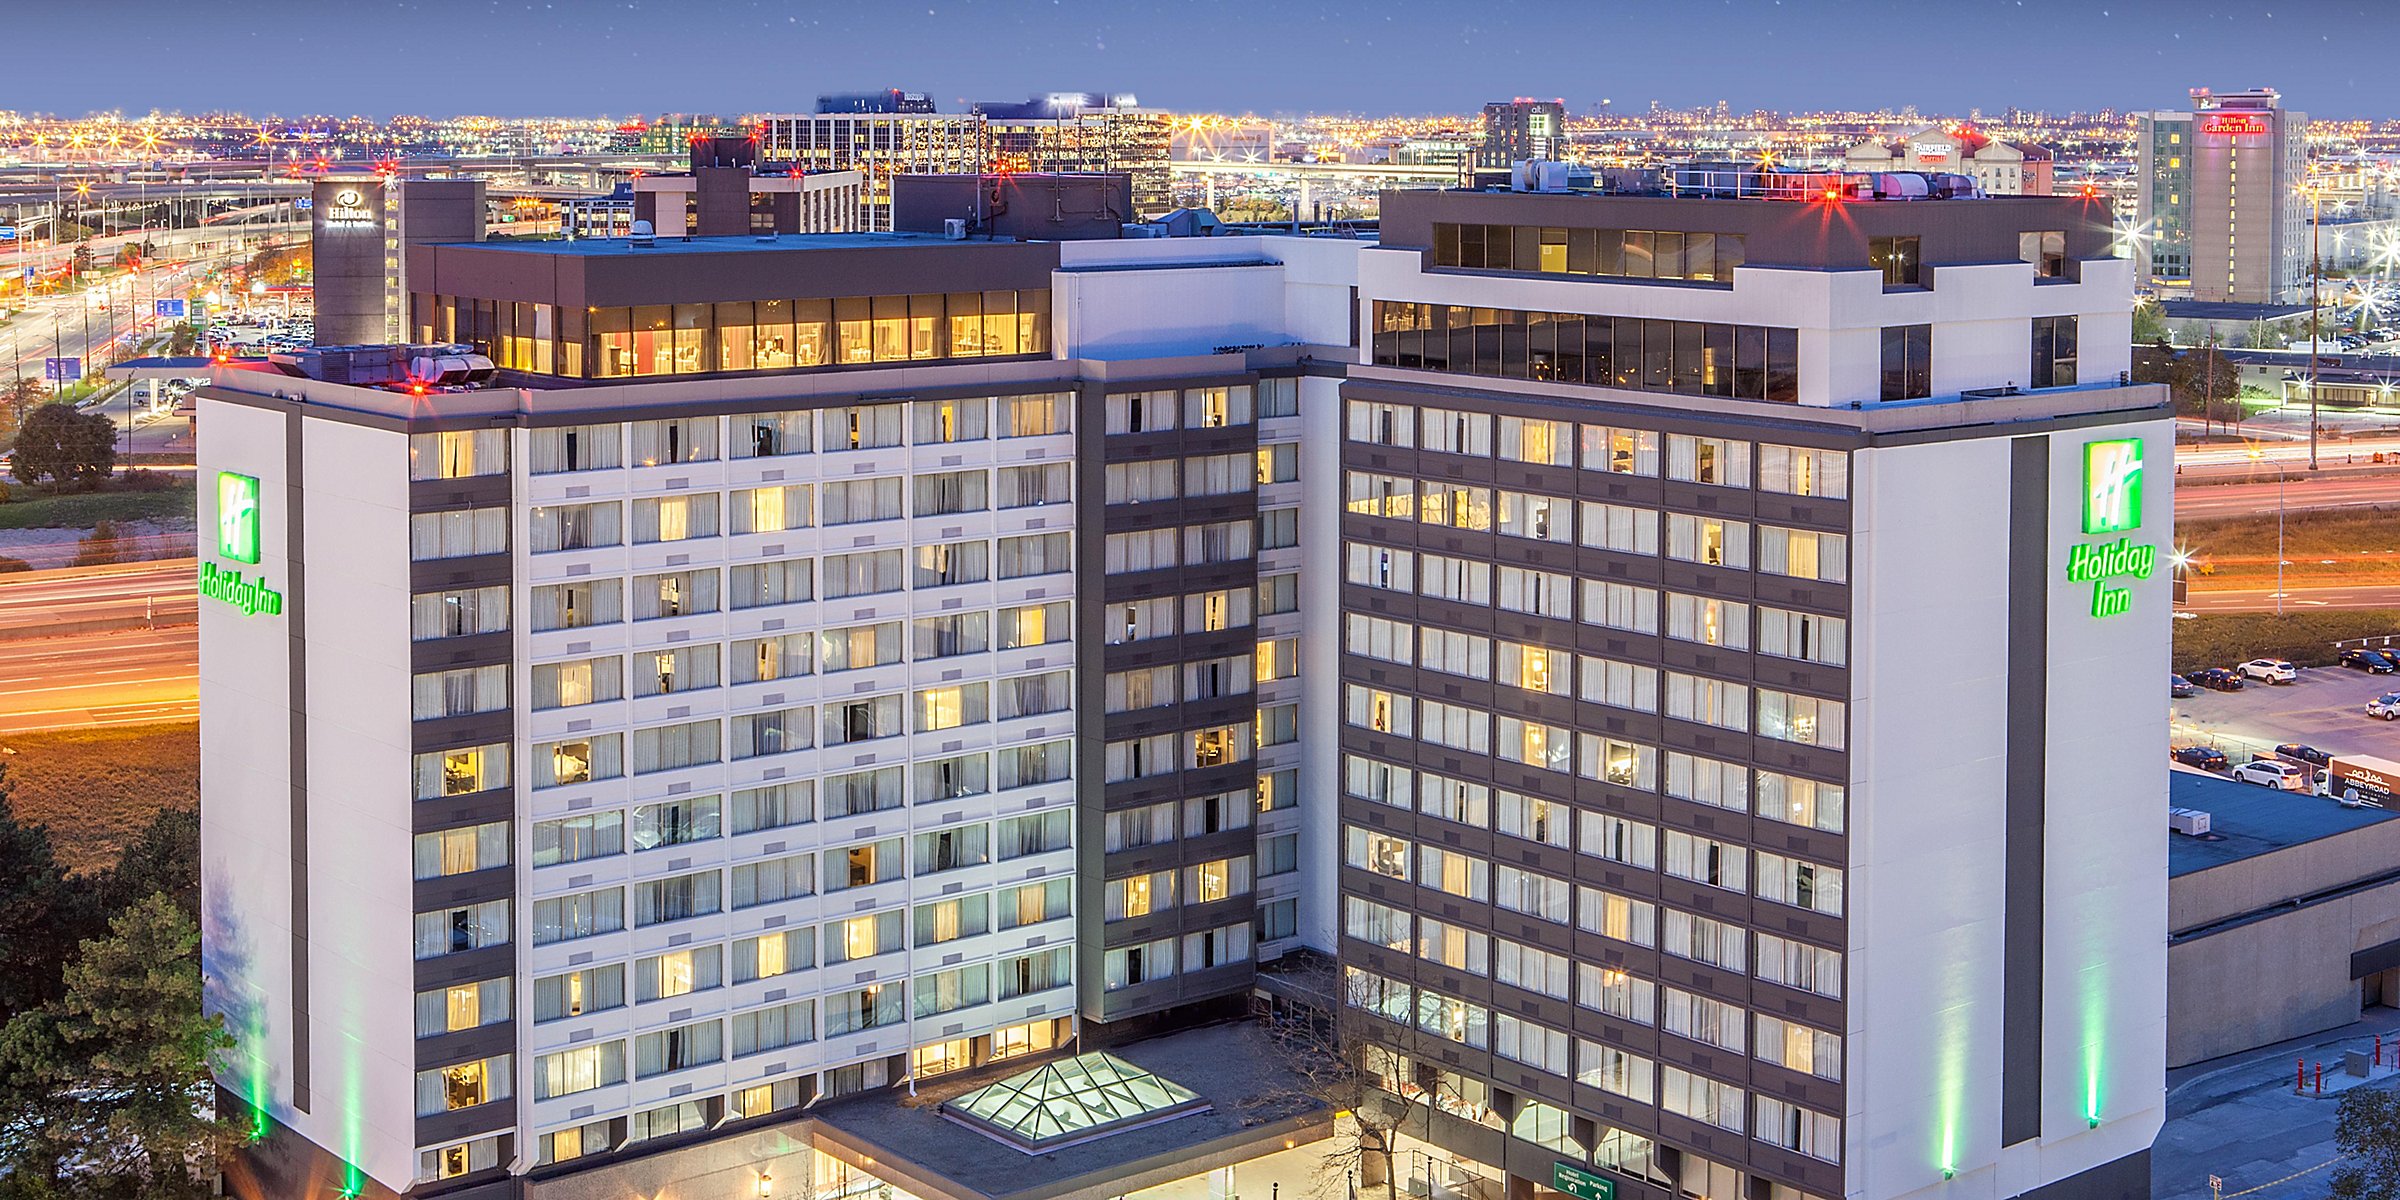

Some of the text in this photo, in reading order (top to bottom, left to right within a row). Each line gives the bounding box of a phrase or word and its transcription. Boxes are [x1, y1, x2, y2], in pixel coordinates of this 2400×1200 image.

[2204, 124, 2263, 132] Garden Inn
[1913, 142, 1951, 152] FAIRFIELD
[328, 206, 372, 219] Hilton
[2067, 538, 2155, 582] Holiday
[199, 561, 282, 616] Holiday Inn
[2091, 581, 2131, 618] Inn
[2344, 777, 2390, 795] ABBEYROAD
[1558, 1171, 1587, 1187] Registration
[1589, 1180, 1608, 1193] Parking
